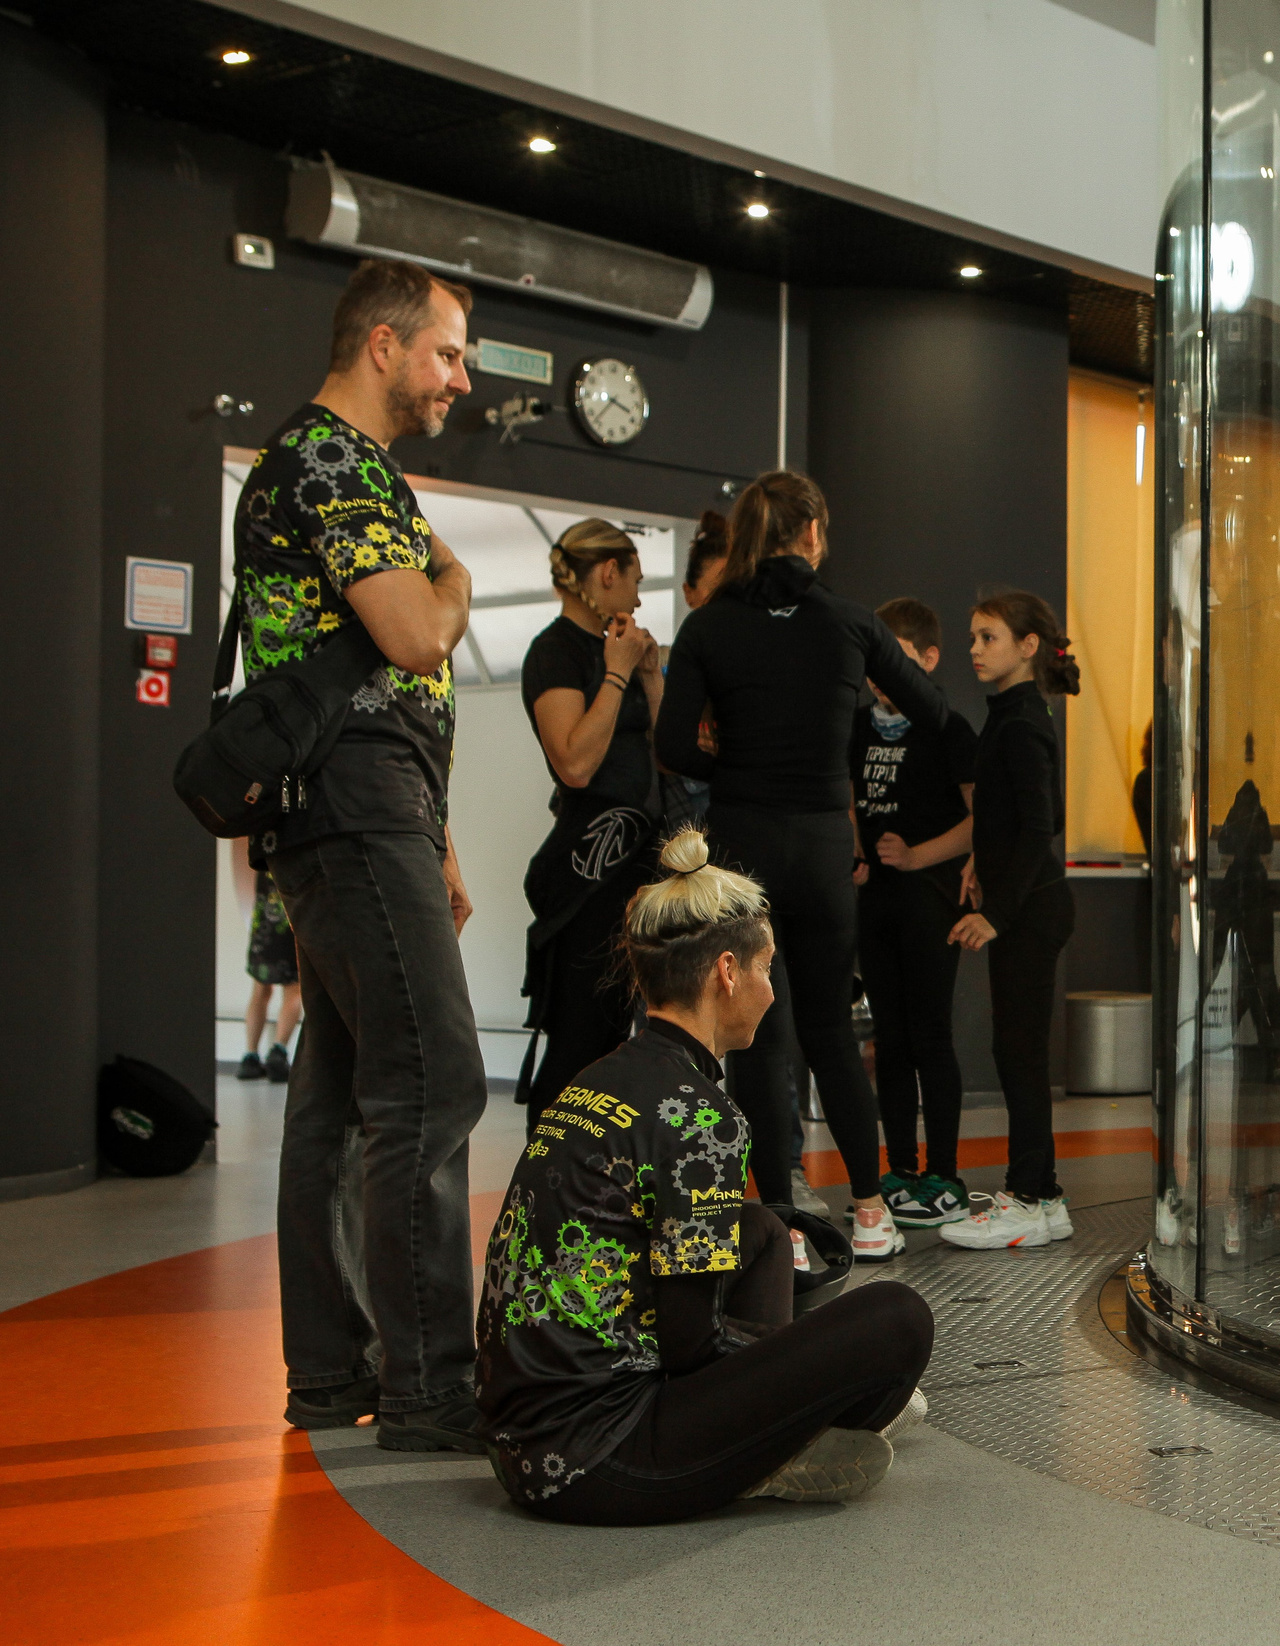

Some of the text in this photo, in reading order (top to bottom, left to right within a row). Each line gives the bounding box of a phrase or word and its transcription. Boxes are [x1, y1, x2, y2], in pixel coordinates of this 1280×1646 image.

[535, 1124, 567, 1140] FESTIVAL
[555, 1111, 606, 1138] SKYDIVING
[526, 1138, 550, 1160] 2023
